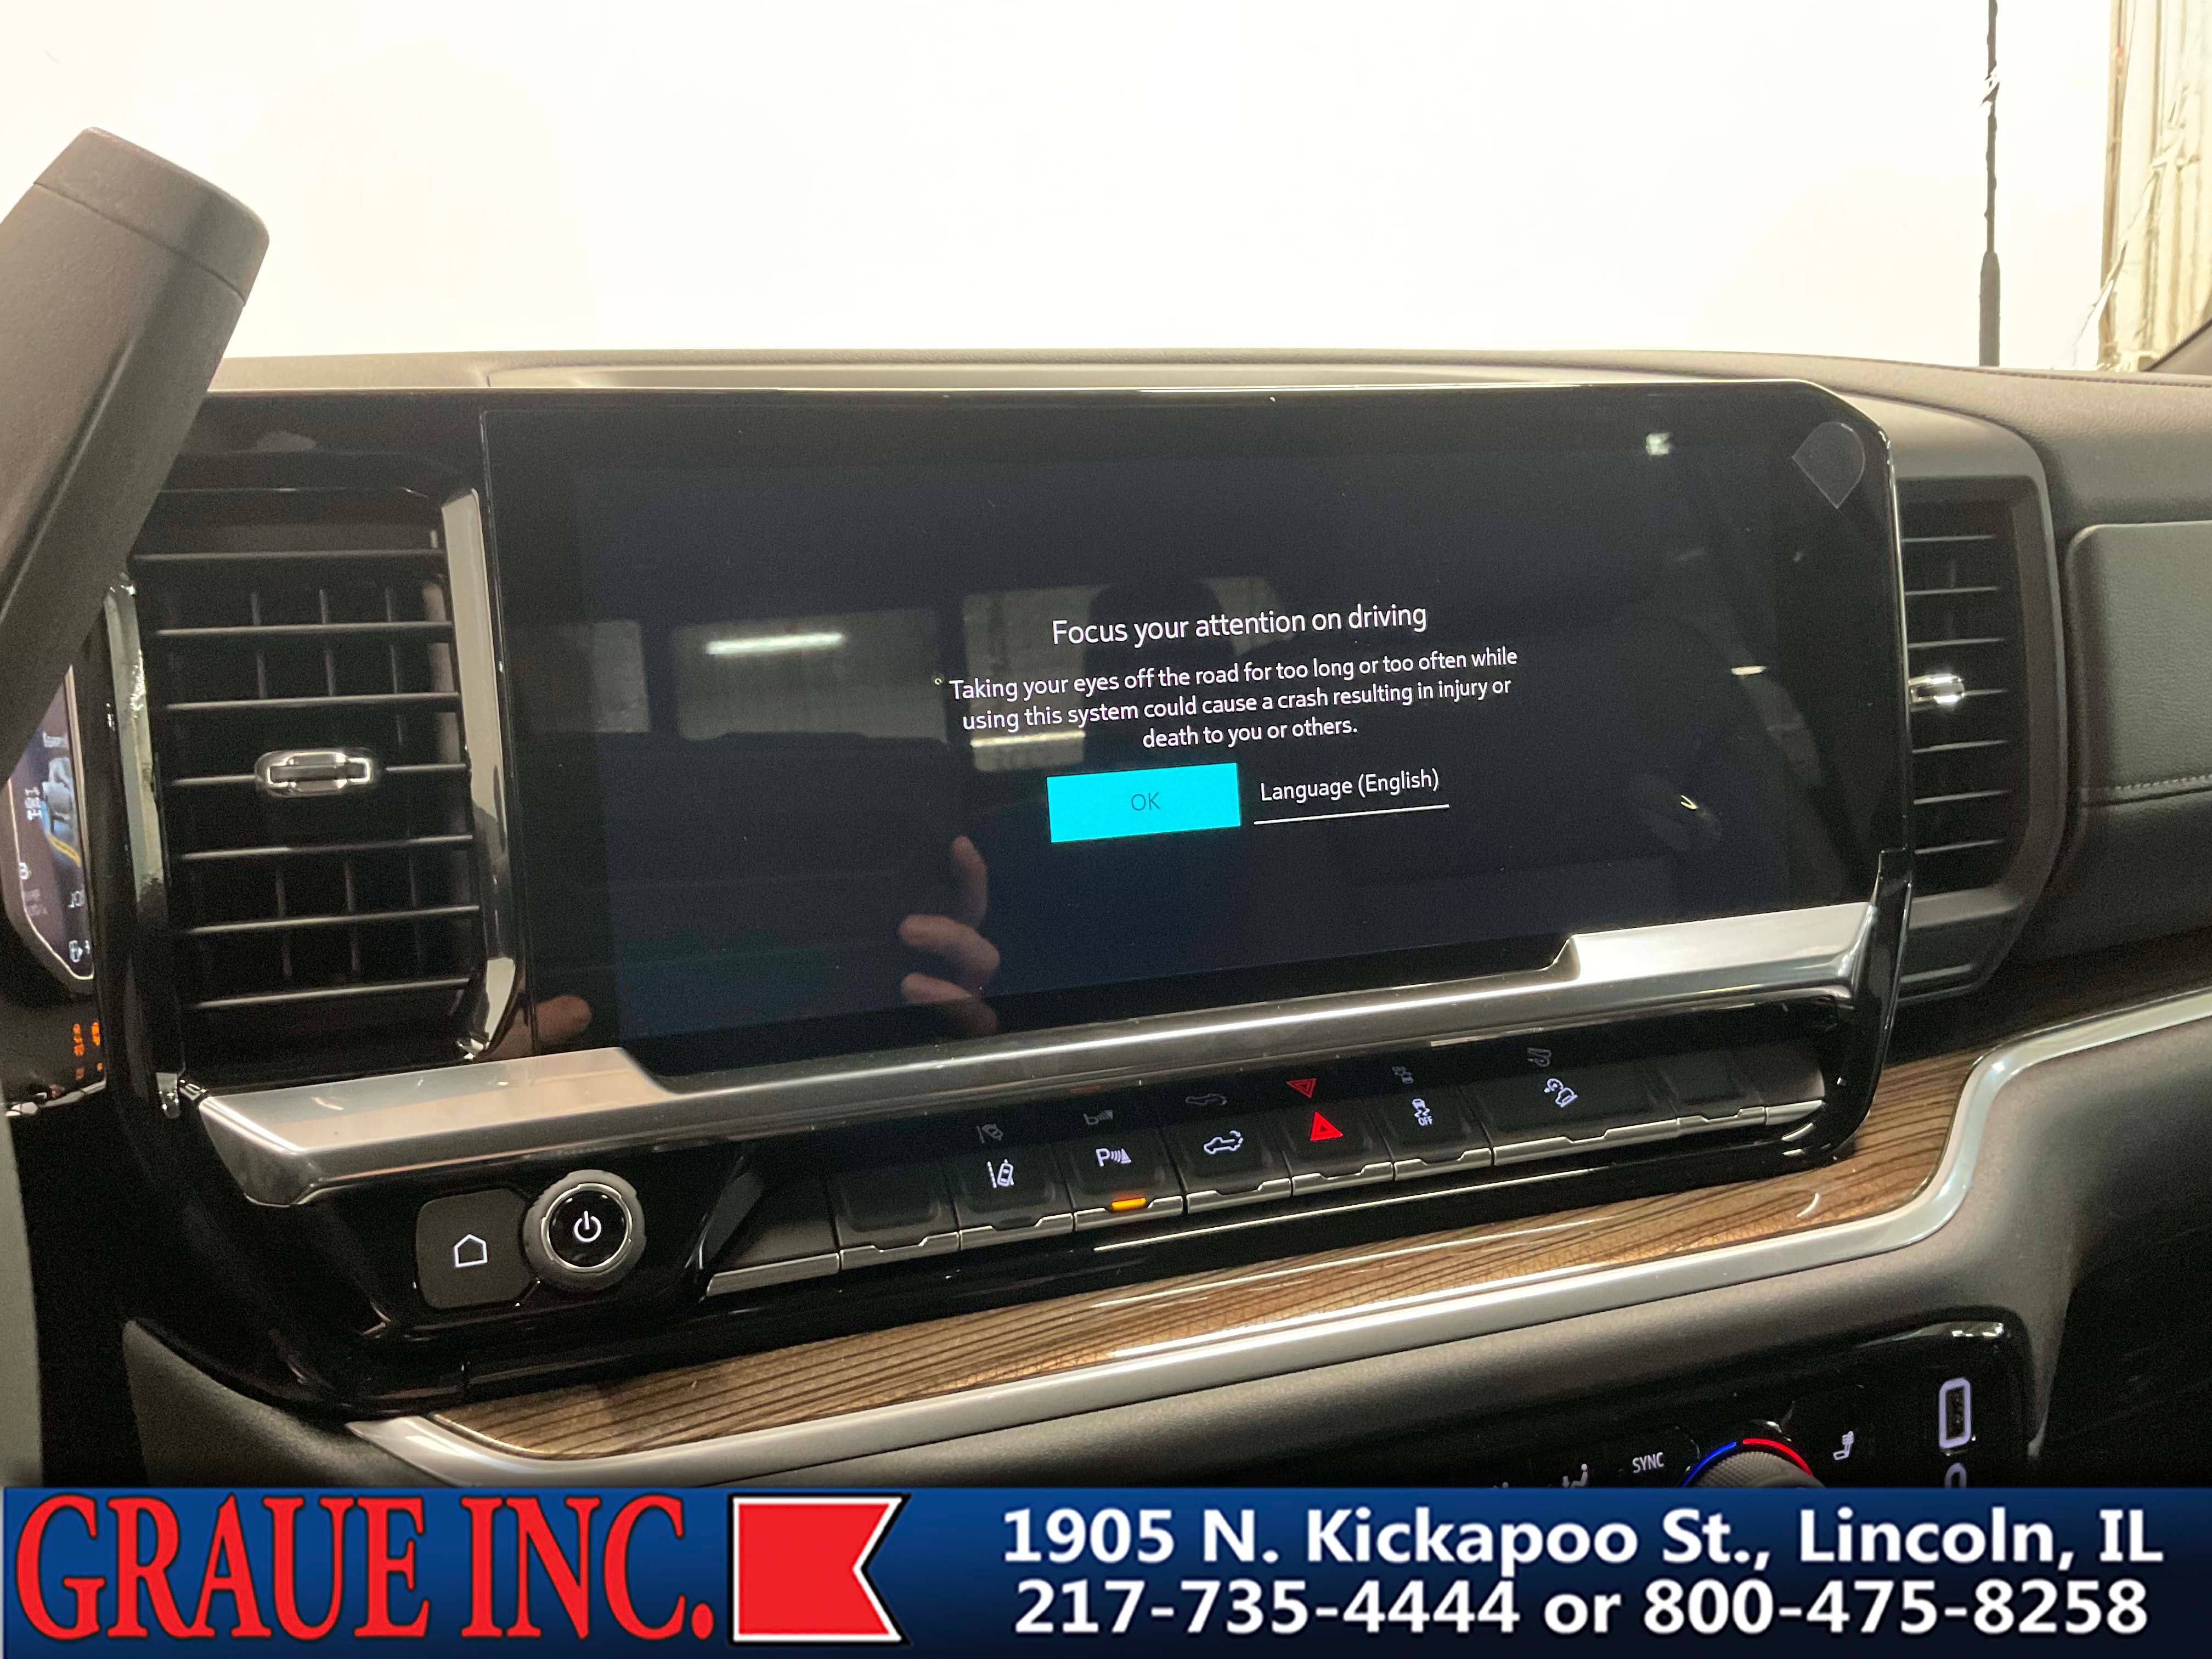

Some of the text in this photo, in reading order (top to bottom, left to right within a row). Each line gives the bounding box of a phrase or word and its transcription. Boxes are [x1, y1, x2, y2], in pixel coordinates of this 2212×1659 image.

[1052, 603, 1426, 648] Focus your attention on driving
[948, 646, 1517, 702] Taking your eyes off the road for too long or too often while
[963, 679, 1511, 733] using this system could cause a crash resulting in injury or
[1143, 716, 1357, 748] death to you or others.
[1130, 792, 1161, 812] OK
[1261, 768, 1439, 804] Language (English)
[1418, 1116, 1433, 1126] OFF
[1632, 1451, 1664, 1474] SYNC
